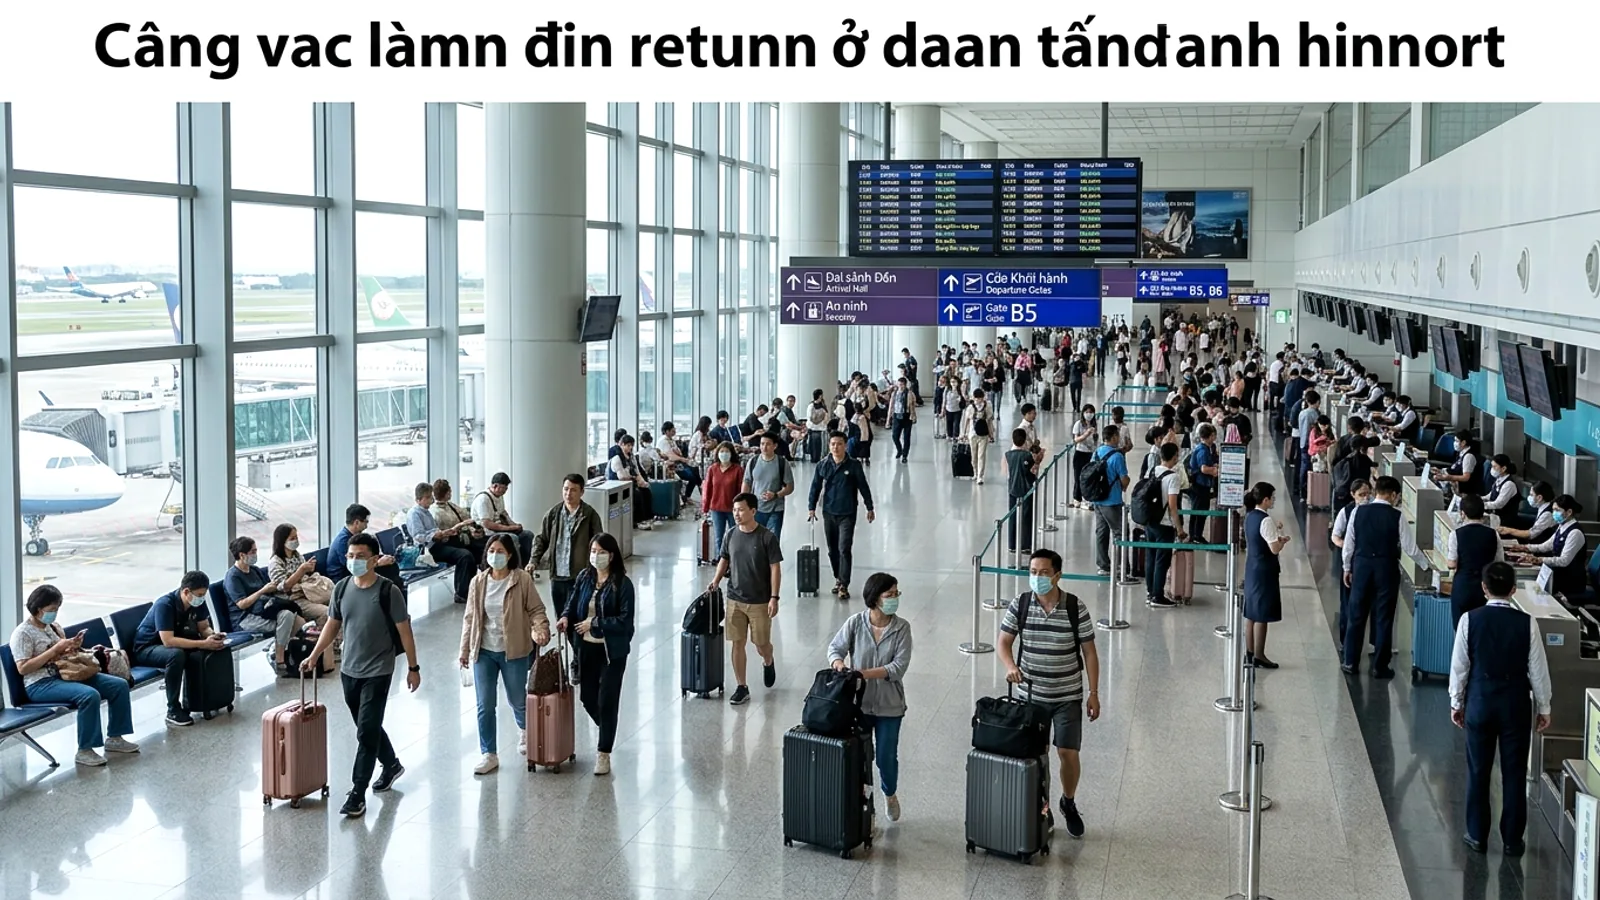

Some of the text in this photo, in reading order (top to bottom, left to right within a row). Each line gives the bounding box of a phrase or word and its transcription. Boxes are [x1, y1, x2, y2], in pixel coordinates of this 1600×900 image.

[843, 300, 868, 311] ninh
[985, 303, 1008, 312] Gate
[1011, 303, 1037, 323] B5
